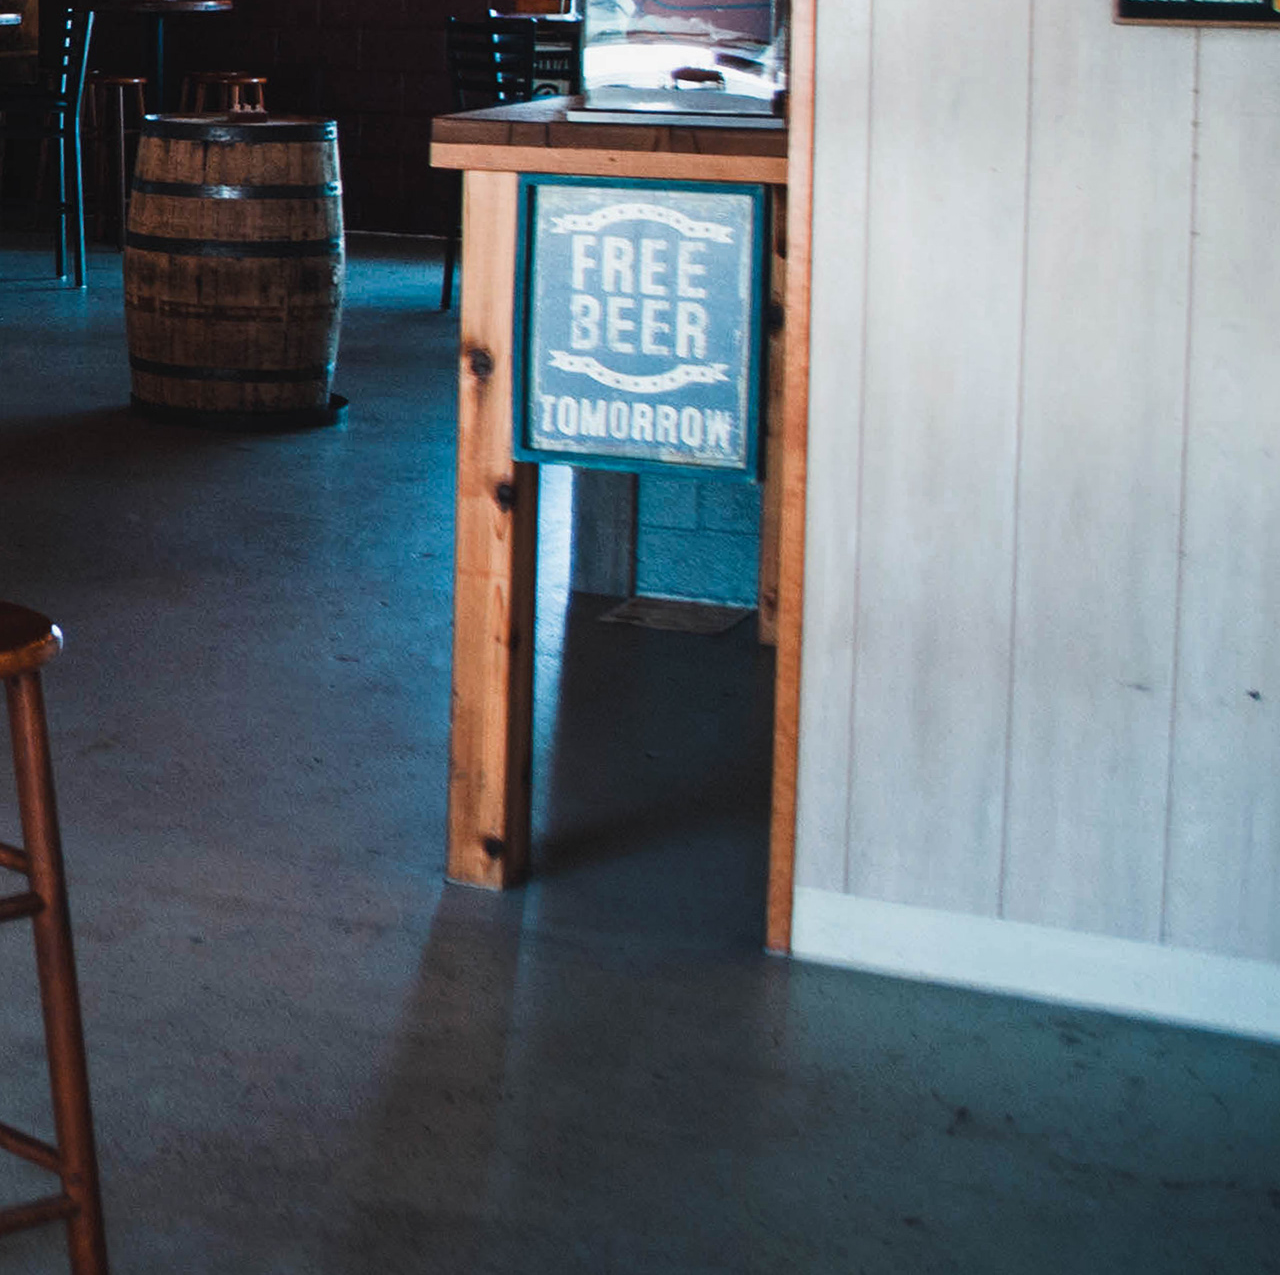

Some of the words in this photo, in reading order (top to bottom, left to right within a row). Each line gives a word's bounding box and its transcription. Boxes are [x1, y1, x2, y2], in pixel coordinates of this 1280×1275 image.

[571, 234, 707, 299] FREE
[570, 294, 708, 359] BEER
[540, 394, 732, 449] TOMORROW
